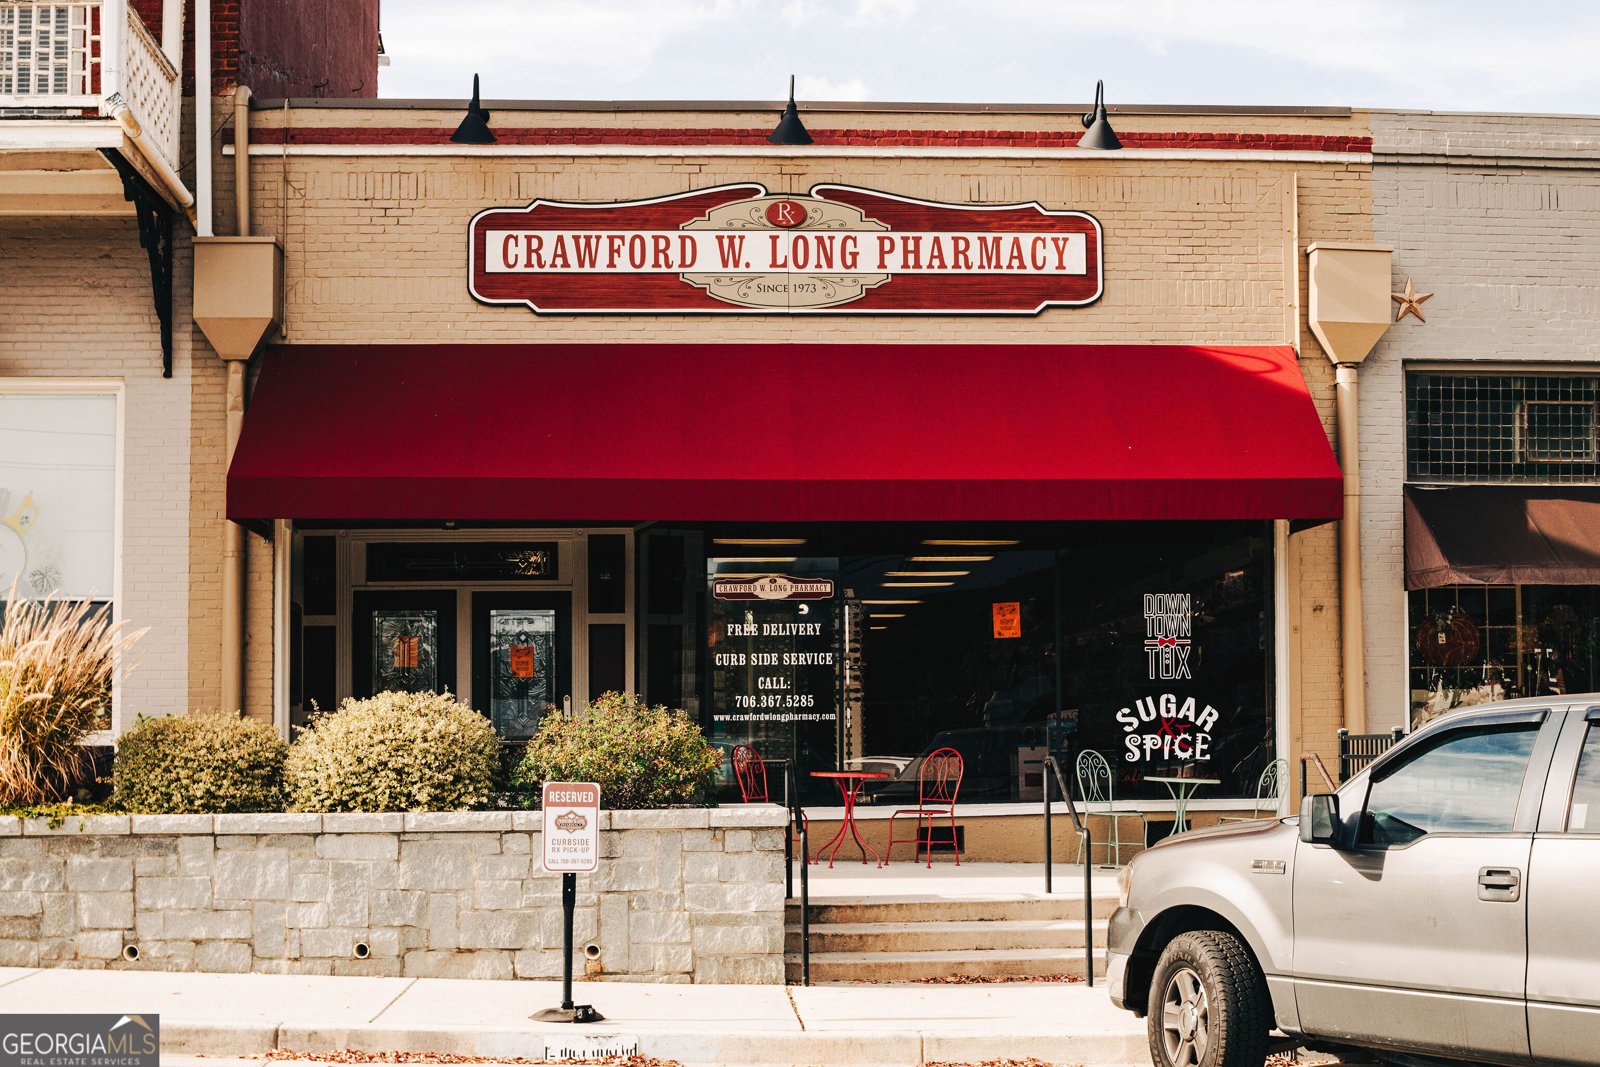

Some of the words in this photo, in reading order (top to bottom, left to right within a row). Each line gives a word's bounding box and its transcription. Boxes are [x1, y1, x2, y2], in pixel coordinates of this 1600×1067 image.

[502, 233, 698, 270] CRAWFORD
[715, 234, 751, 269] W.
[769, 234, 860, 270] LONG
[876, 235, 1070, 271] PHARMACY
[793, 283, 817, 293] 1973
[719, 584, 757, 592] CRAWFORD
[759, 584, 767, 592] W.
[769, 584, 788, 592] LONG
[790, 584, 828, 592] PHARMACY
[1144, 594, 1191, 616] DOWN
[727, 623, 759, 636] FREE
[762, 623, 822, 636] DELIVERY
[1145, 614, 1191, 637] TOWN
[715, 653, 746, 666] CURB
[750, 653, 779, 666] SIDE
[783, 652, 833, 666] SERVICE
[1144, 646, 1192, 679] TUX
[758, 677, 791, 689] CALL:
[735, 695, 814, 708] 706.367.5285
[713, 712, 836, 722] www.crawfordwlongpharmacy.com
[1116, 693, 1219, 733] SUGAR
[1124, 732, 1212, 763] SPICE
[549, 791, 594, 803] RESERVED
[551, 838, 590, 846] CURBSIDE
